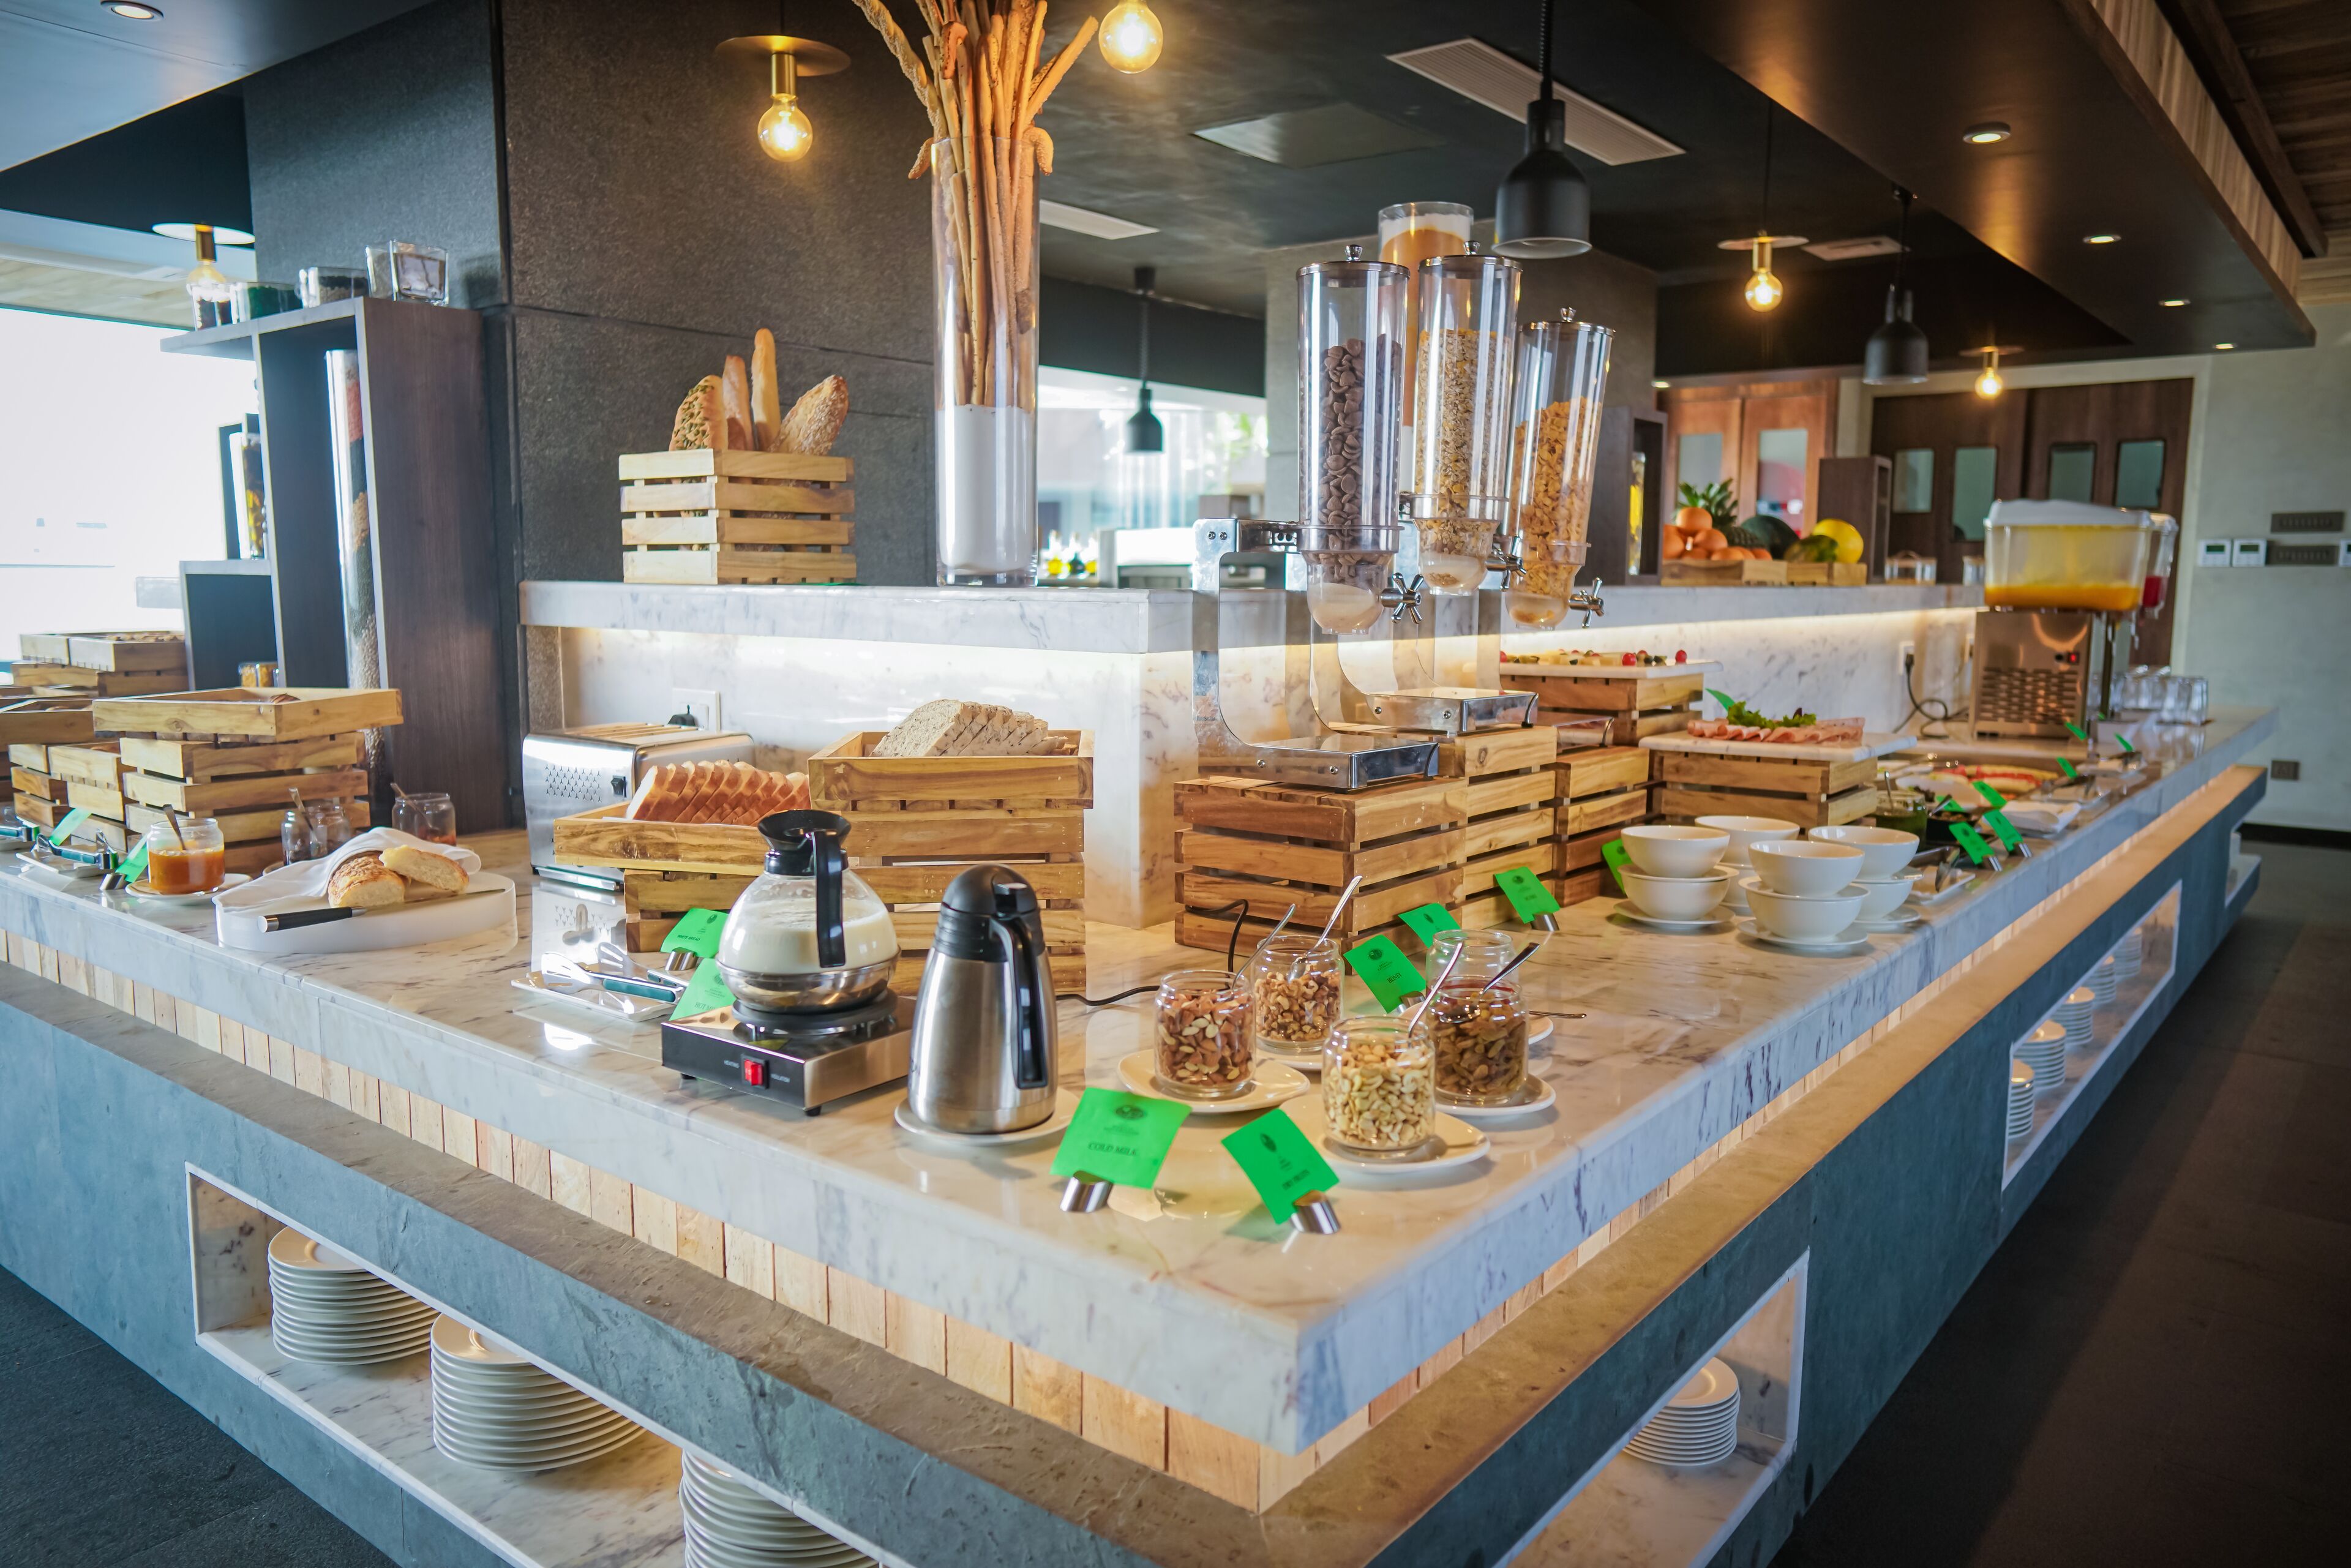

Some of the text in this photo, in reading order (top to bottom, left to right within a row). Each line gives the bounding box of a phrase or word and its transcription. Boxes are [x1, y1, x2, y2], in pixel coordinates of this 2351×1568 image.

[1387, 973, 1402, 983] HONEY
[1087, 1142, 1138, 1156] COLD MILK
